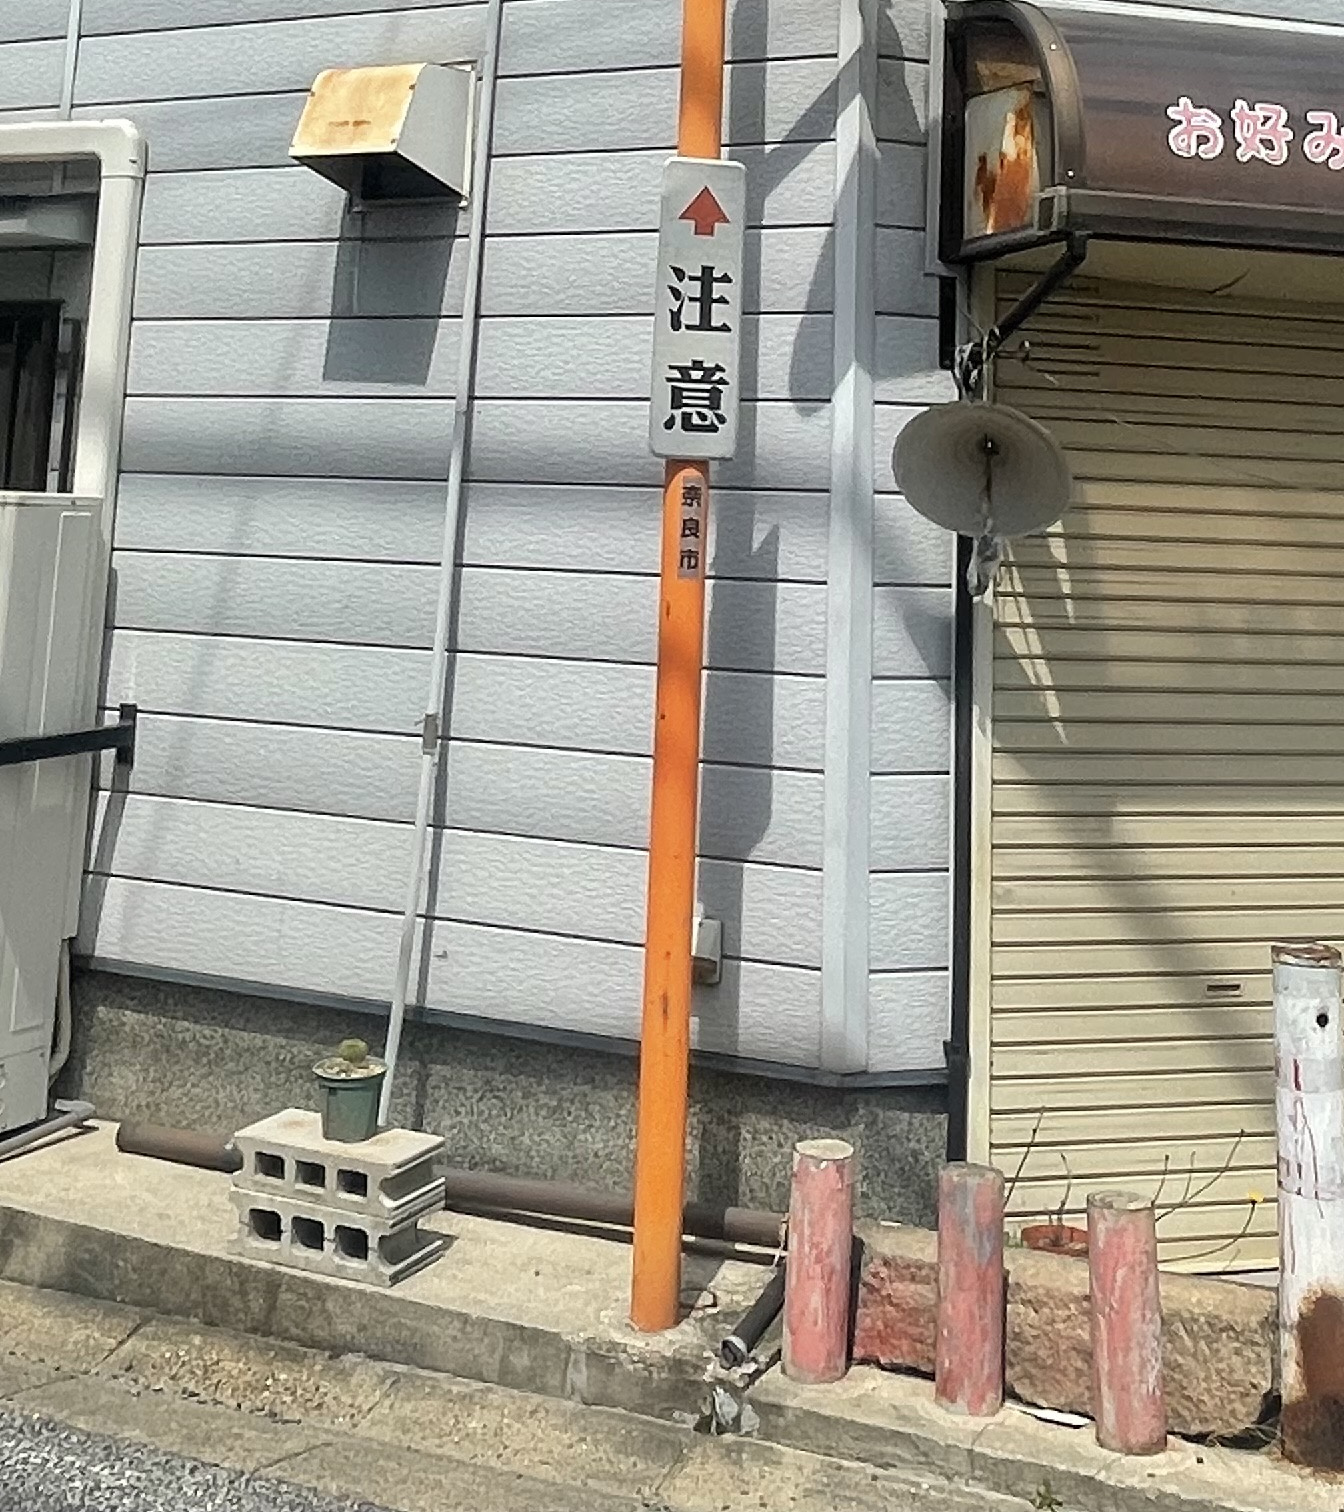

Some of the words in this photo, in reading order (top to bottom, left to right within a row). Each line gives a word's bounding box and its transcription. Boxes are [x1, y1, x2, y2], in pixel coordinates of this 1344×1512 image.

[664, 264, 733, 433] 注意
[680, 485, 703, 572] 奈良市
